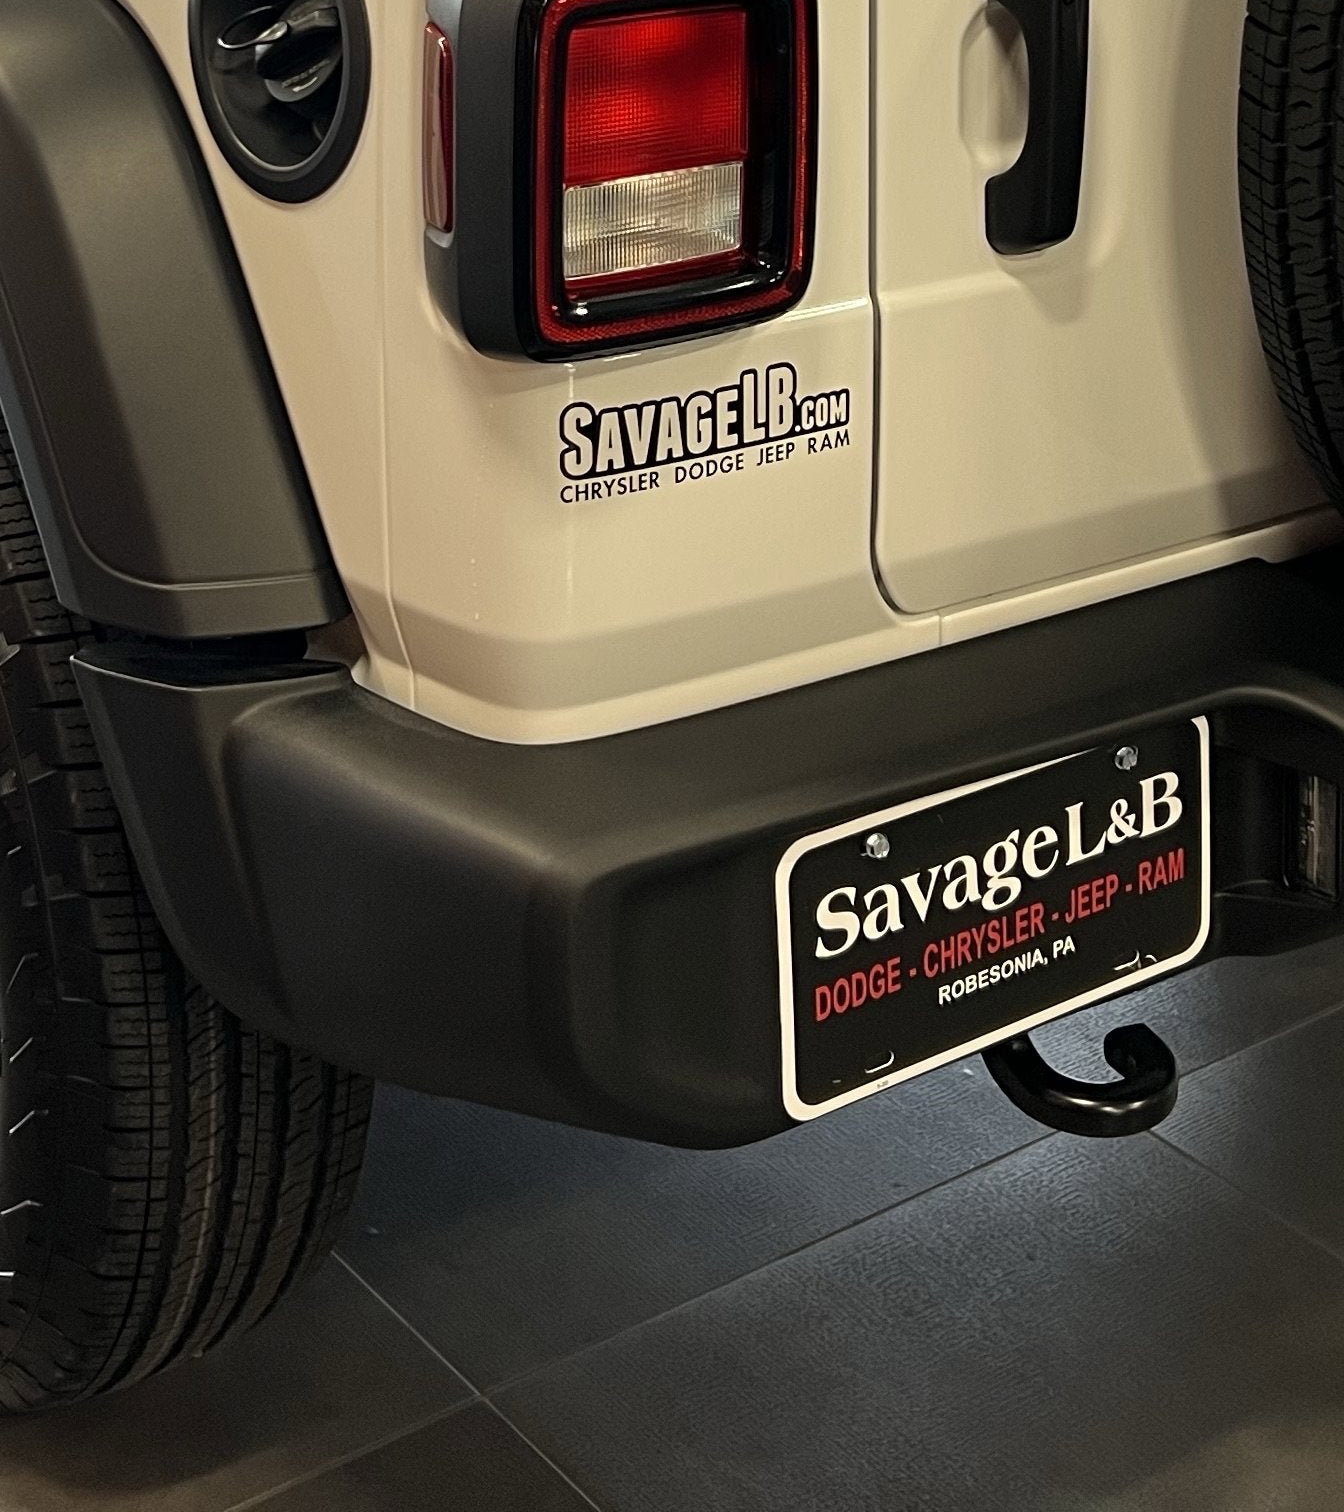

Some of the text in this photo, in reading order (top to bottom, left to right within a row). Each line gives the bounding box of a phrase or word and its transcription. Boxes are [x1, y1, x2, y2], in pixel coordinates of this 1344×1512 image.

[560, 429, 850, 503] CHRYSLER DODGE JEEP RAM
[814, 956, 902, 1022] DODGE
[923, 903, 1045, 978] CHRYSLER
[1064, 874, 1119, 924] JEEP
[1138, 848, 1185, 896] RAM
[938, 935, 1076, 1005] ROBESONIA, PA
